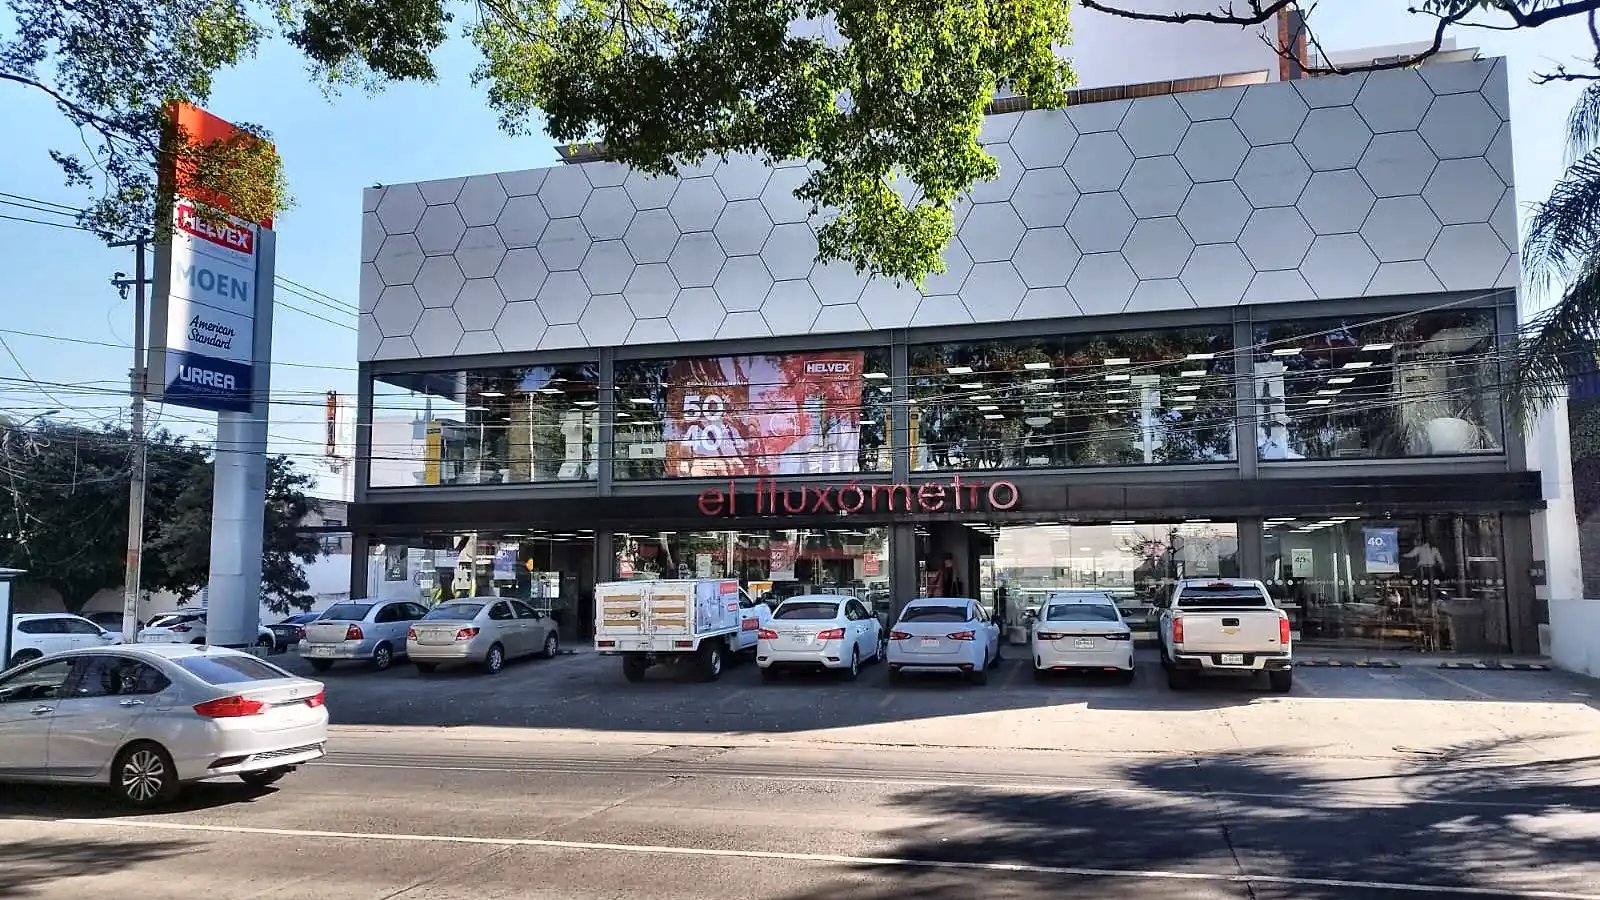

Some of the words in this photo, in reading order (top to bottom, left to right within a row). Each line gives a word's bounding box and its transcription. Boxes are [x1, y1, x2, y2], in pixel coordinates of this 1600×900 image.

[175, 260, 248, 302] MOEN
[189, 315, 236, 337] American
[187, 328, 232, 350] Standard
[179, 364, 236, 391] URREA
[806, 362, 850, 373] HELVEX
[698, 479, 736, 516] el
[754, 473, 1019, 517] fluxómetro
